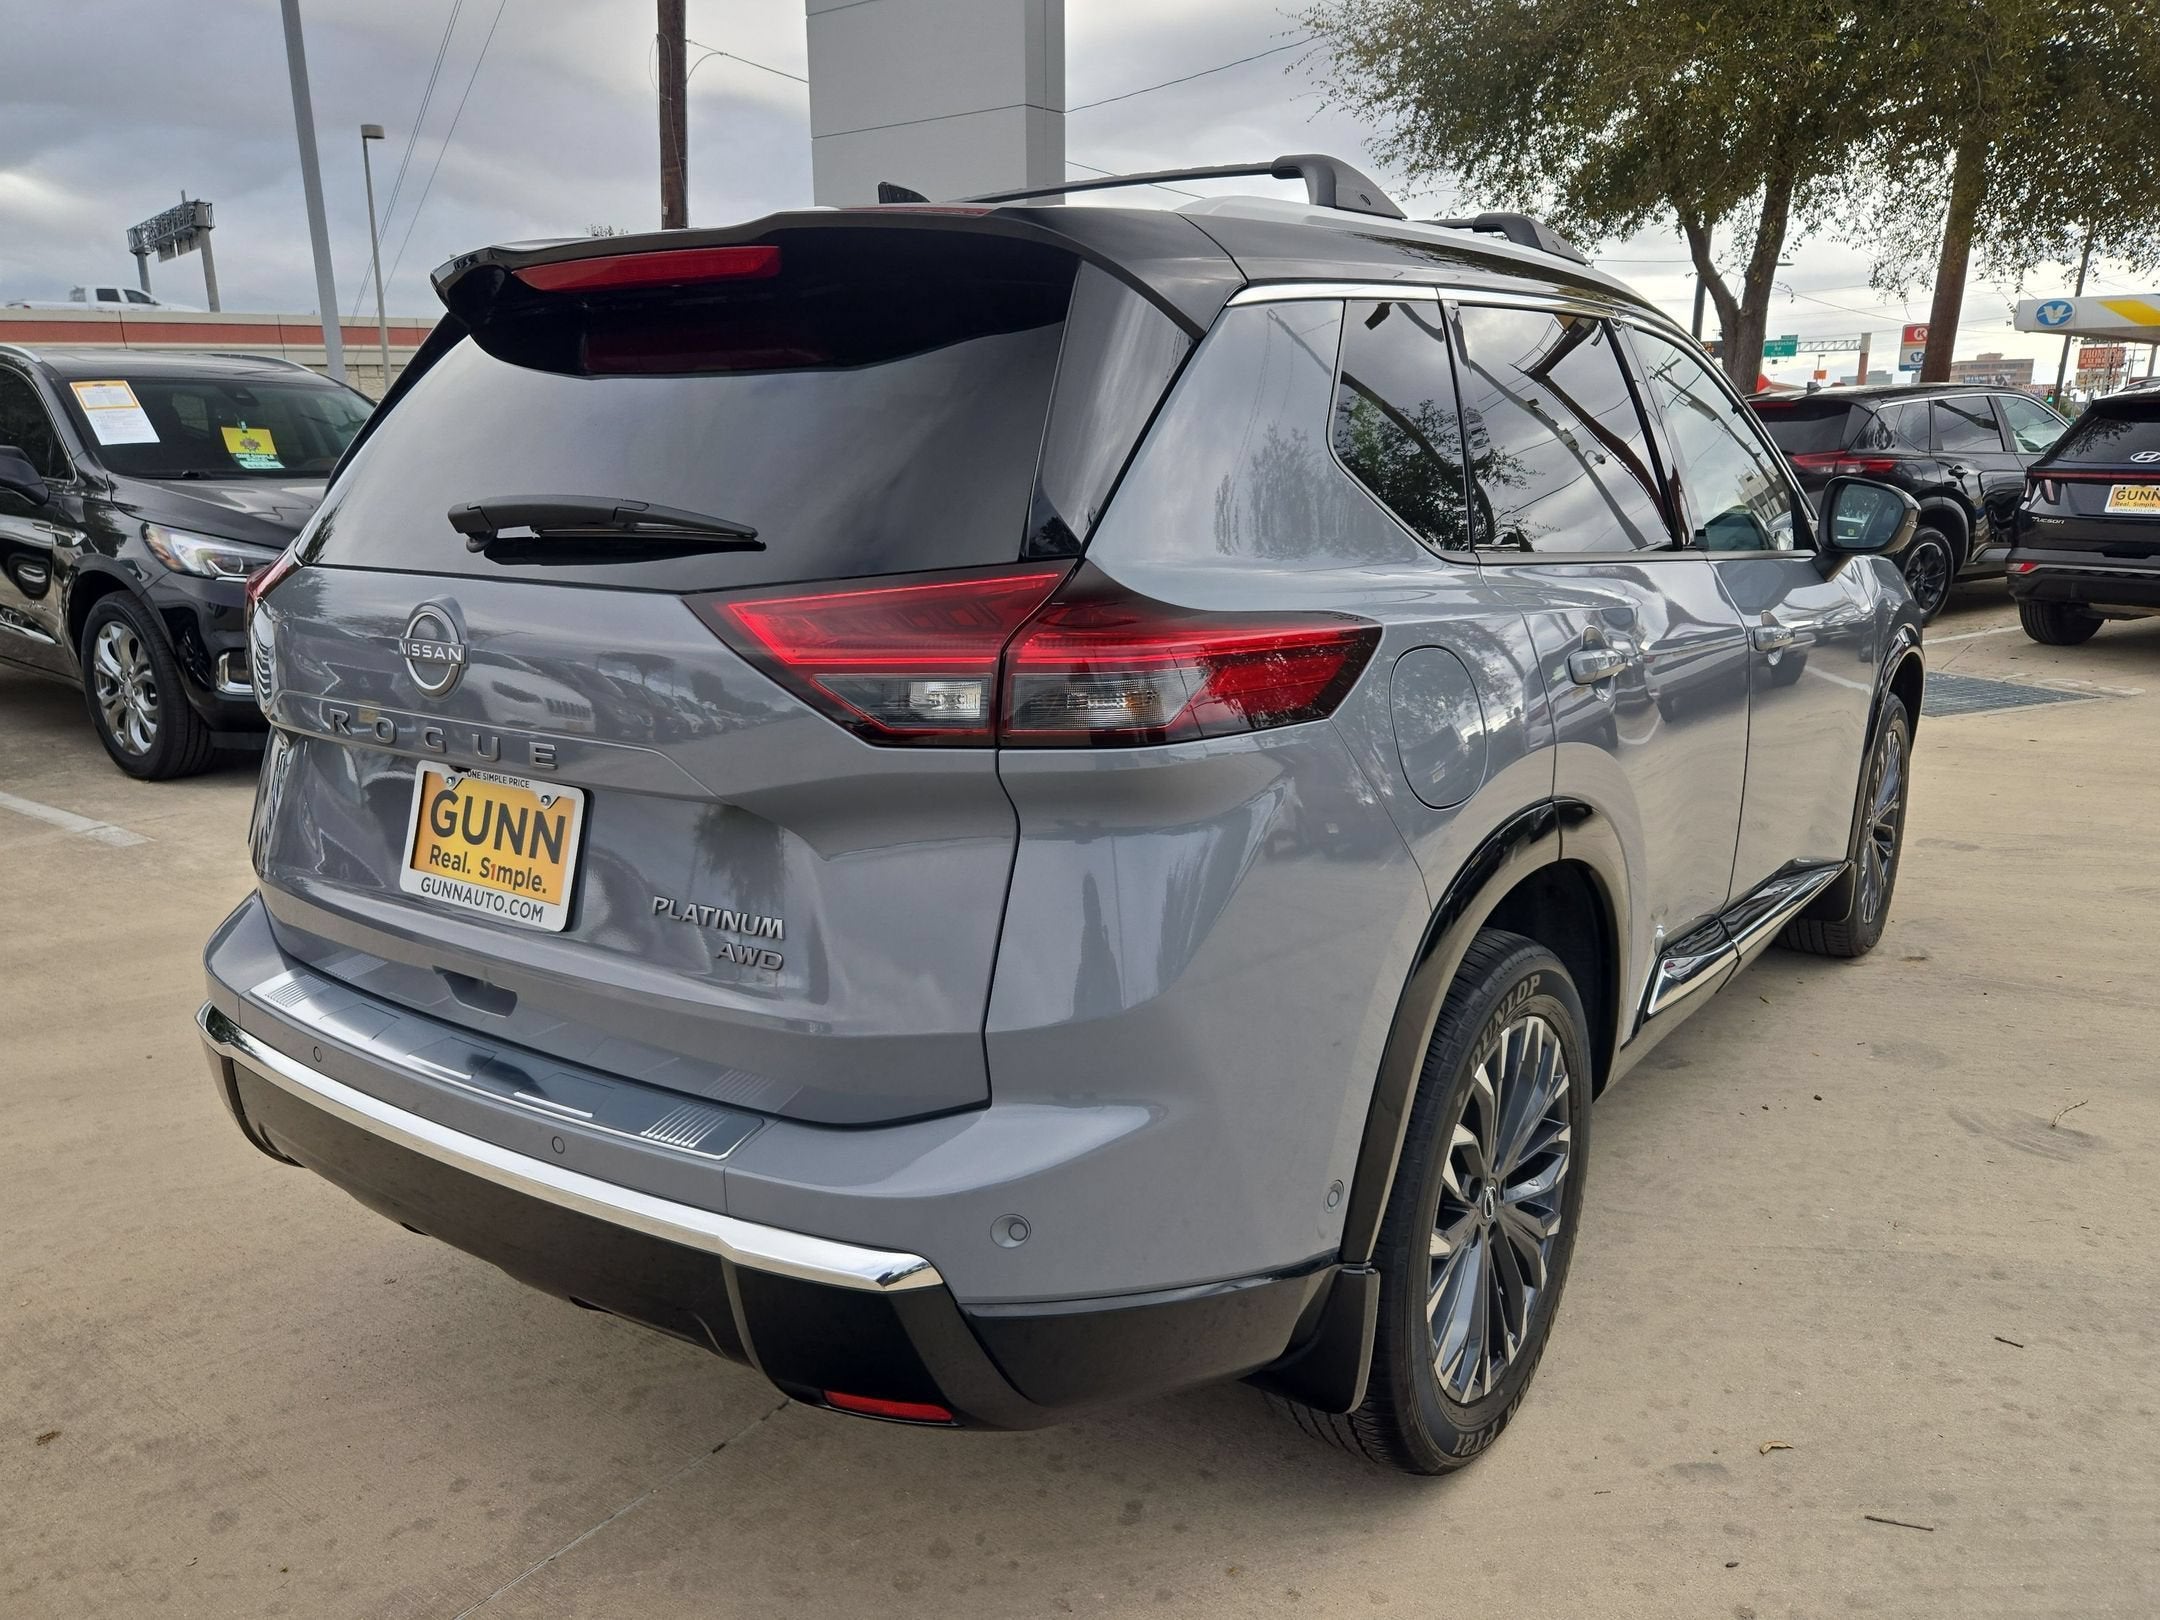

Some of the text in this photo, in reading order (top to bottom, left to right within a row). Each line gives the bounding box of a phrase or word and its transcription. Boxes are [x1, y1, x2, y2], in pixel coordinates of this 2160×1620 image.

[400, 641, 462, 662] NISSAN
[329, 708, 558, 771] ROGUE
[466, 770, 530, 789] ONE SIMPLE PRICE
[430, 789, 566, 865] GUNN
[429, 844, 471, 874] Real.
[420, 876, 544, 923] GUNNAUTO.COM
[652, 895, 785, 940] PLATINUM
[716, 942, 784, 971] AWD
